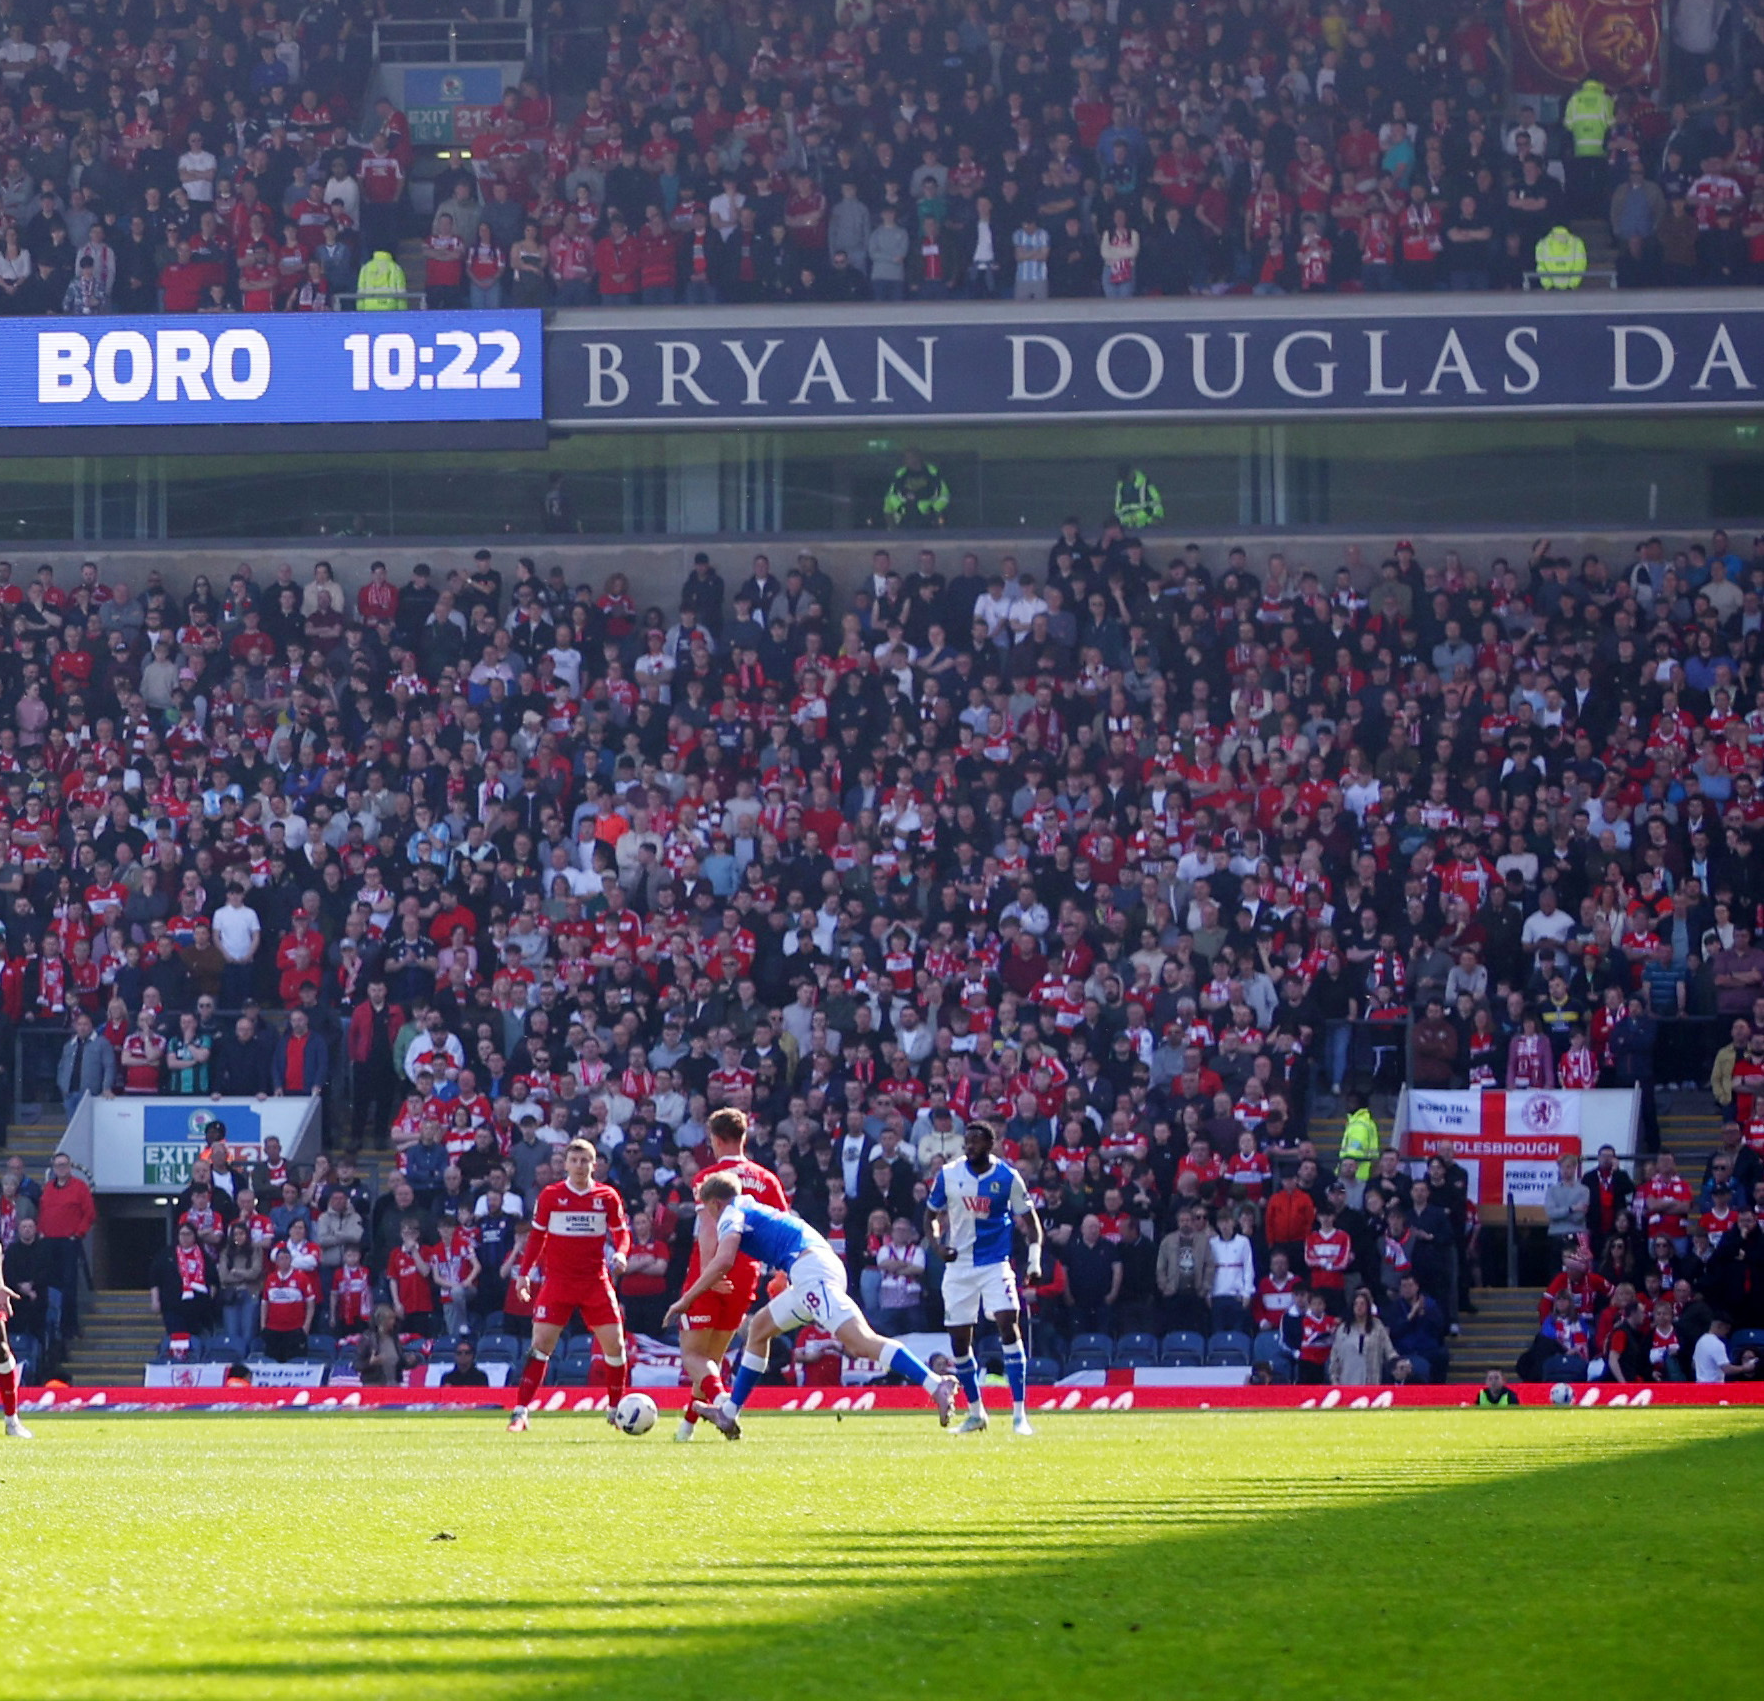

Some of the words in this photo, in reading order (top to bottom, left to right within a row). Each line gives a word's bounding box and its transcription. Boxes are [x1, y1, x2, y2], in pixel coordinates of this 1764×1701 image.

[408, 110, 449, 124] EXIT
[38, 328, 271, 403] BORO
[344, 330, 521, 391] 10:22
[582, 338, 938, 407] BRYAN
[1008, 327, 1540, 400] DOUGLAS
[1608, 322, 1758, 391] DA
[146, 1147, 198, 1164] EXIT
[1424, 1140, 1560, 1155] MDLESBROUGH
[566, 1215, 595, 1223] UNIBET
